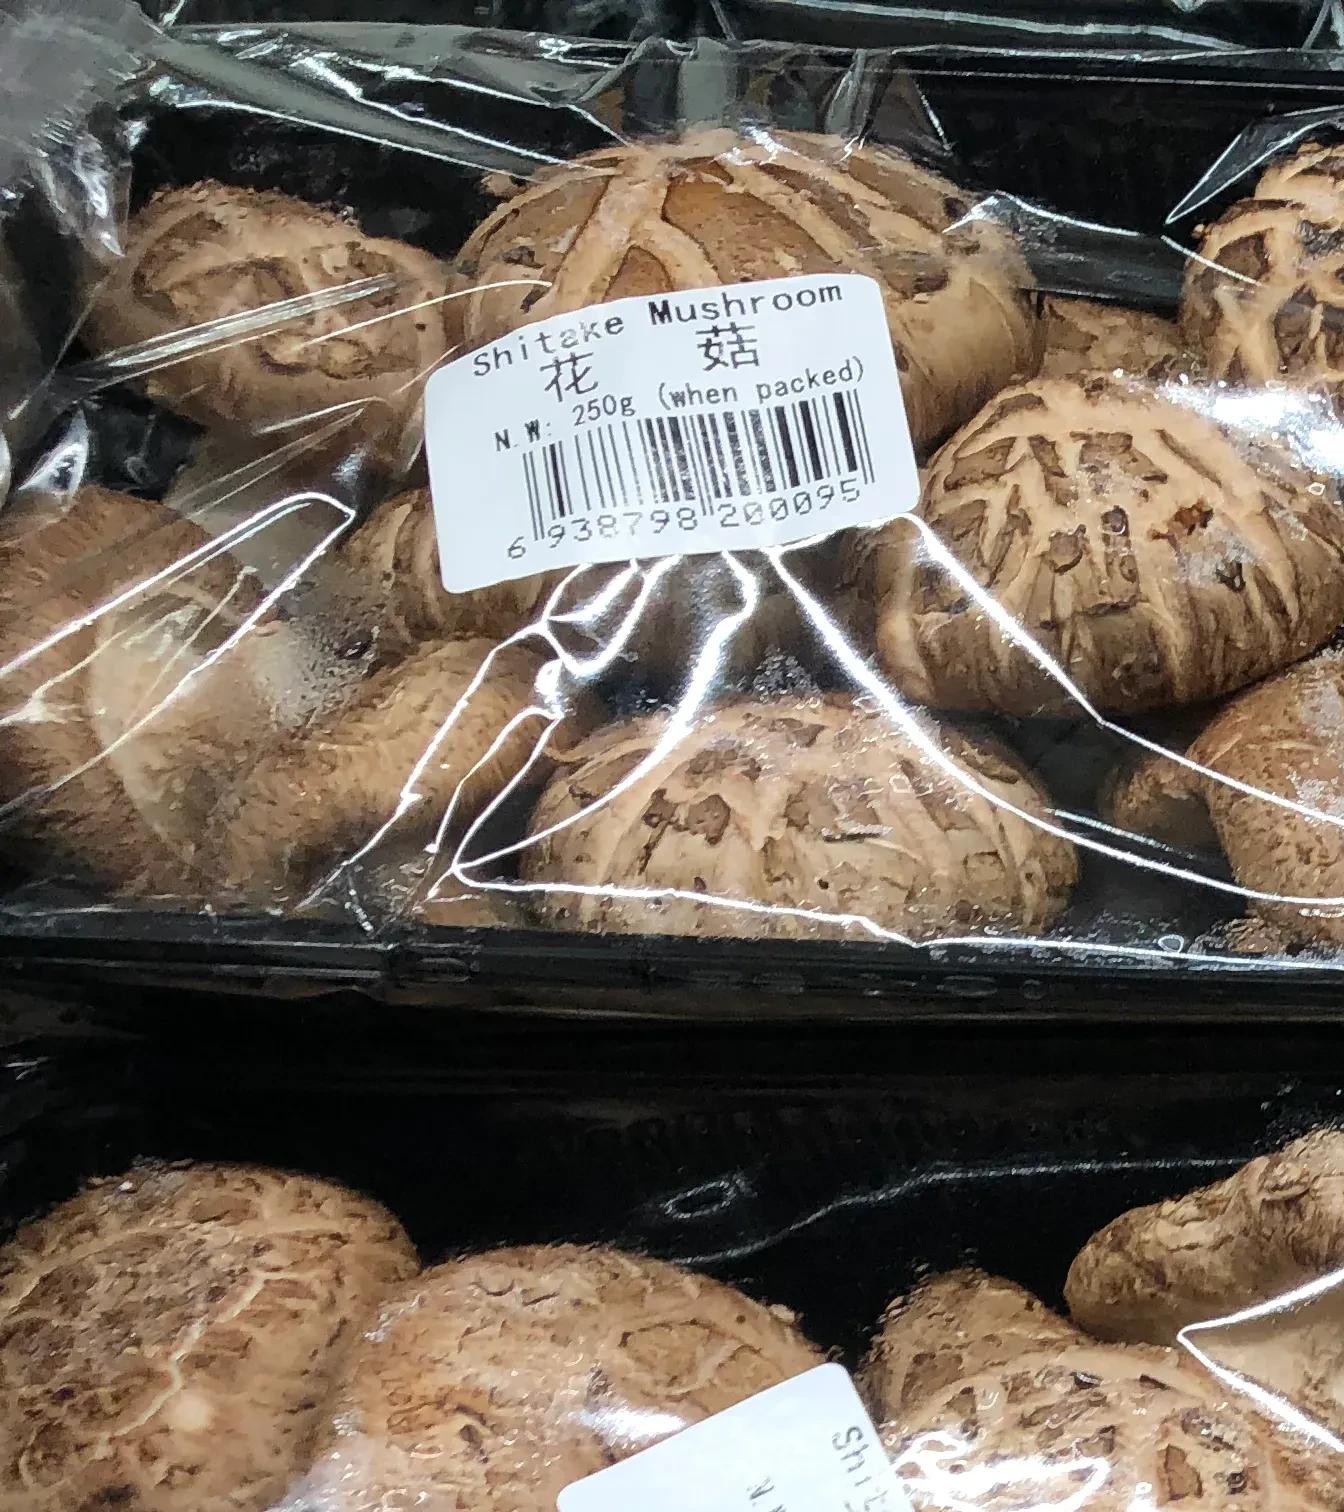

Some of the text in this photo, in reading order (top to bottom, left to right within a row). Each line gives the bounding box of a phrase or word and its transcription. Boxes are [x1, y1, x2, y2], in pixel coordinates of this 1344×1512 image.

[473, 281, 844, 378] Shitake Mushroom
[572, 394, 637, 428] 250g
[657, 383, 739, 413] (when
[755, 355, 865, 404] packed)
